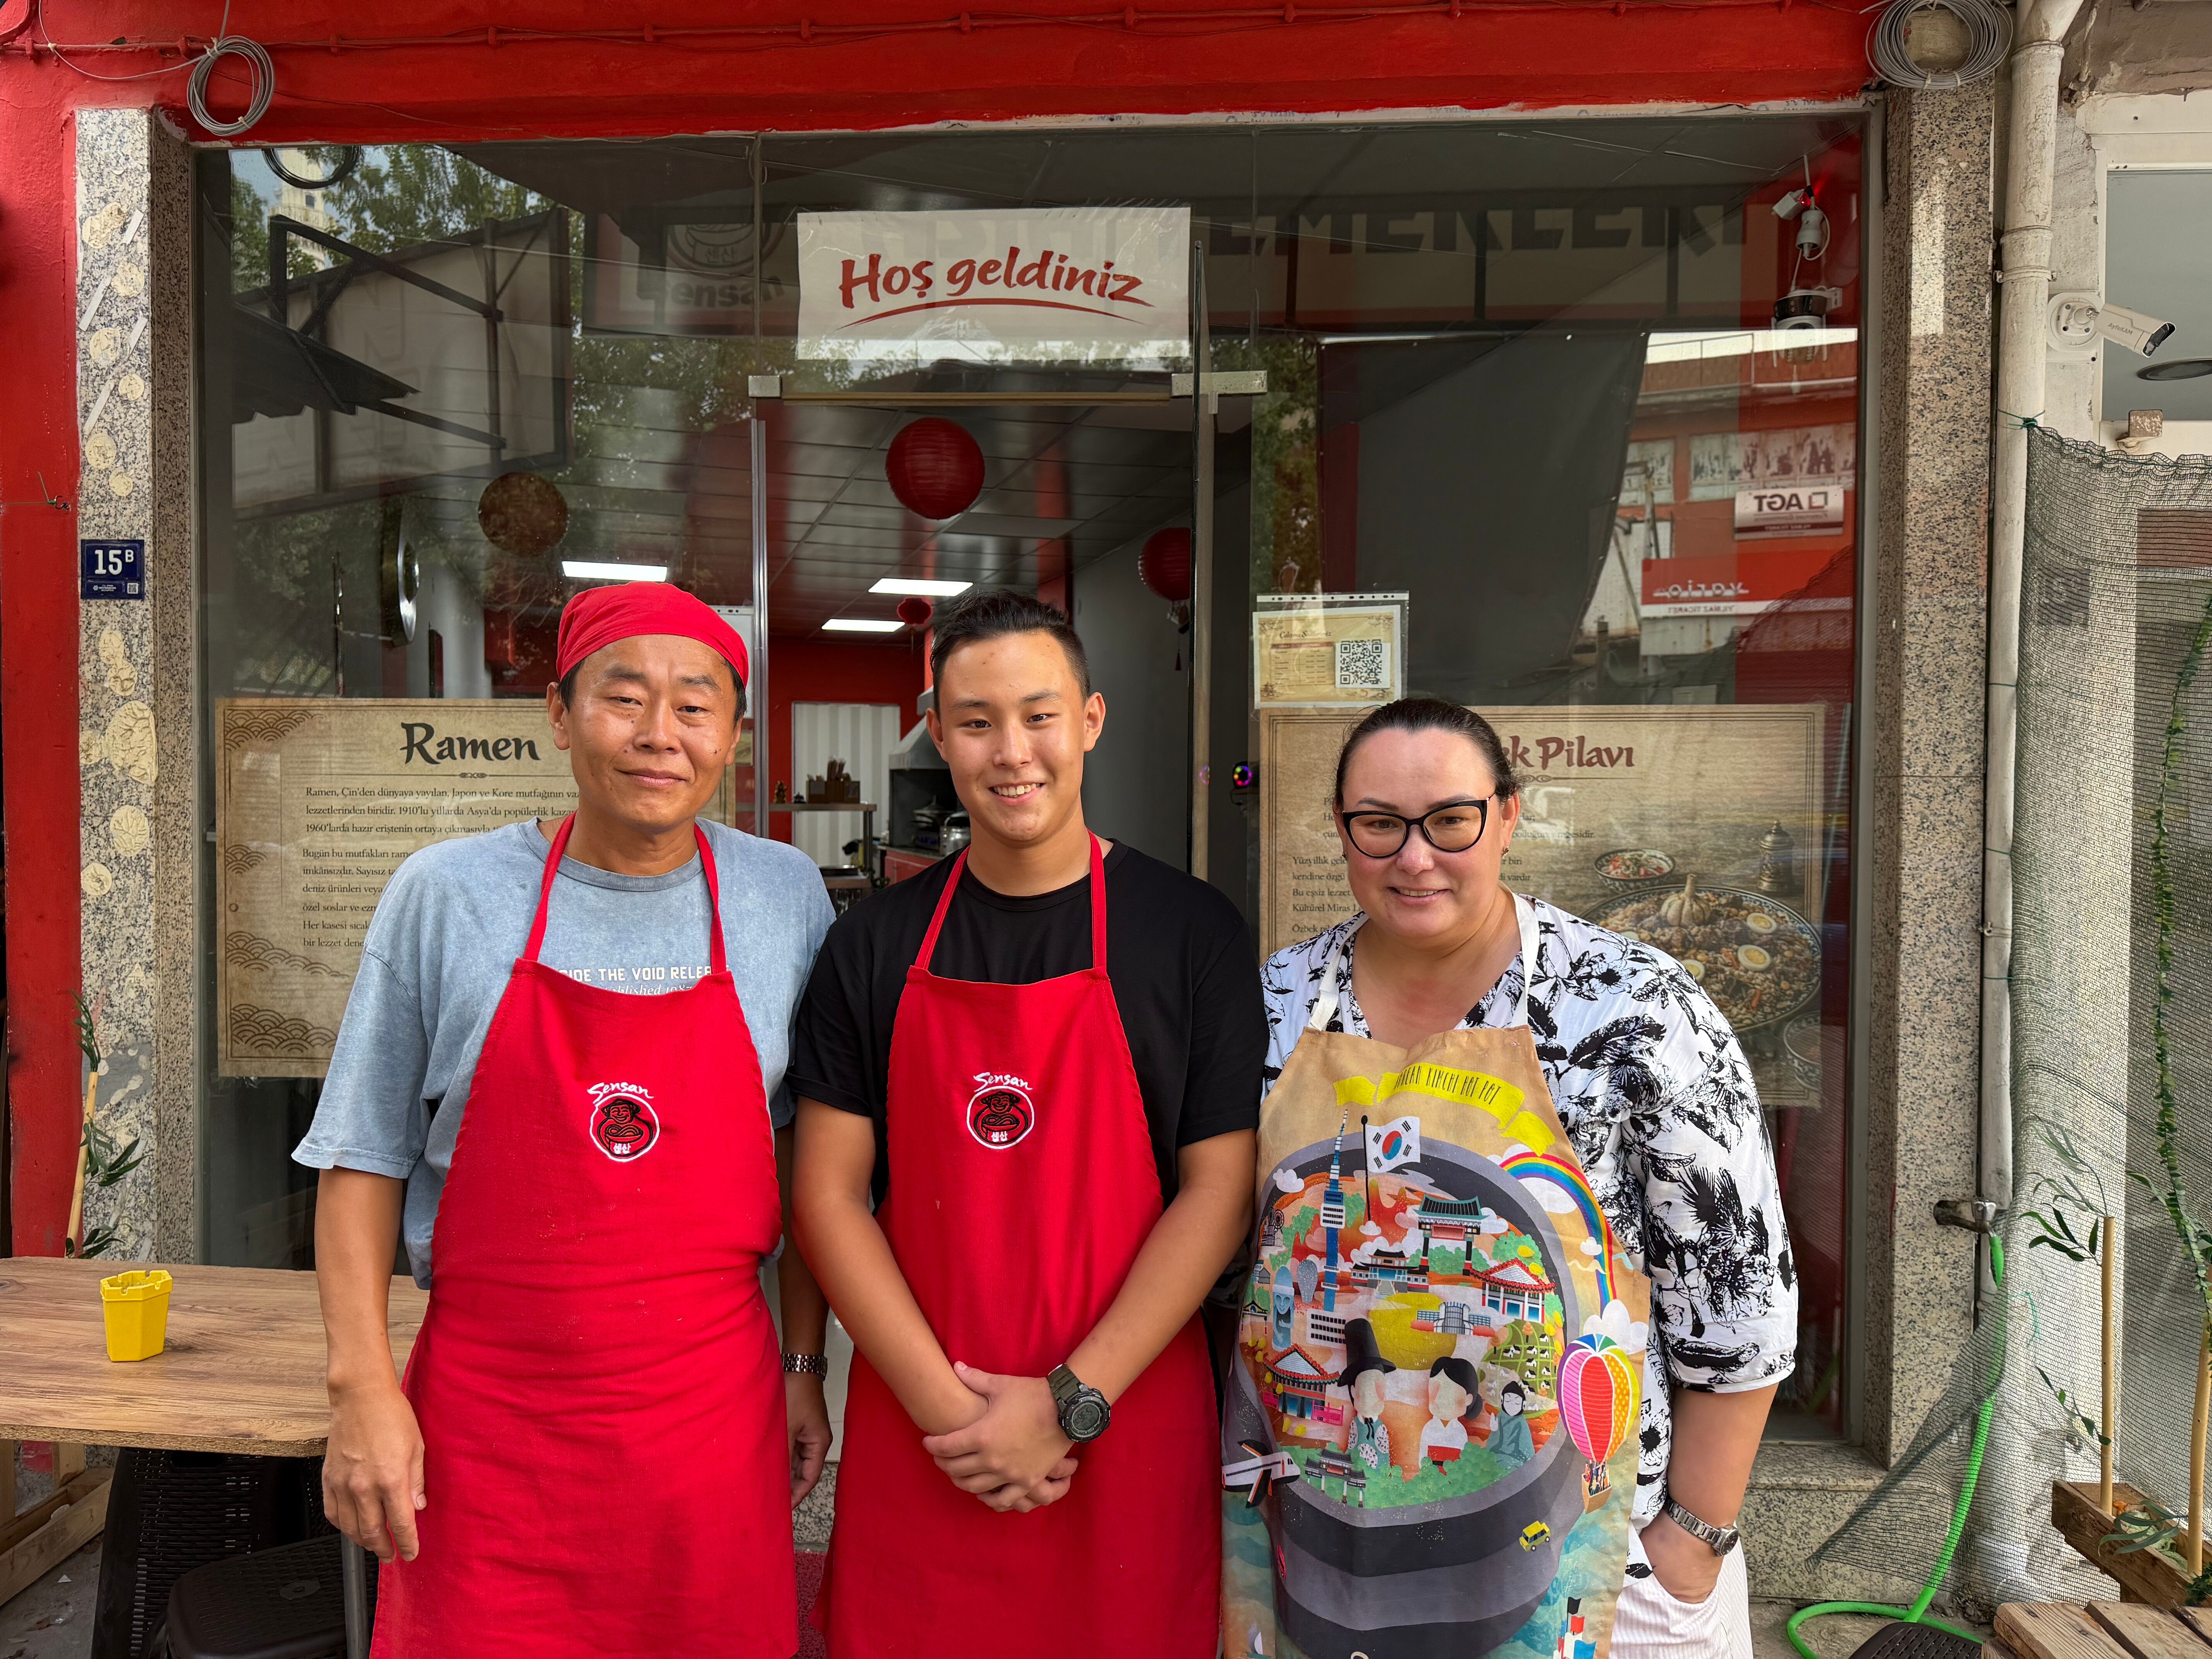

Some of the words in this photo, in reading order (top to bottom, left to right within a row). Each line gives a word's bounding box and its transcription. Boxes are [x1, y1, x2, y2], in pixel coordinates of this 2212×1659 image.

[838, 253, 934, 309] Hoş
[946, 246, 1155, 308] geldiniz
[400, 722, 541, 764] Ramen
[1535, 736, 1635, 770] Pilavı
[306, 787, 338, 797] Ramen,
[342, 787, 375, 798] Çin'den
[378, 788, 413, 799] dünyaya
[416, 788, 449, 799] yayılan,
[452, 788, 477, 799] Japon
[492, 789, 513, 797] Kore
[516, 789, 563, 799] mutfağının
[306, 805, 365, 814] lezzetlerinden
[368, 806, 395, 814] biridir.
[399, 806, 428, 815] 1910'lu
[467, 807, 501, 817] Asya'da
[504, 806, 549, 817] popülerlik
[306, 824, 349, 832] 1960'larda
[352, 824, 372, 832] hazır
[376, 824, 412, 834] eriştenin
[415, 825, 441, 835] ortaya
[302, 849, 329, 859] Bugün
[332, 849, 343, 857] bu
[345, 849, 388, 857] mutfakları
[357, 866, 385, 877] Sayısız
[1326, 872, 1345, 882] özgü
[303, 884, 325, 893] deniz
[328, 884, 361, 893] ürünleri
[364, 887, 383, 895] veya
[1293, 903, 1324, 912] Kültürel
[303, 921, 319, 929] Her
[322, 921, 347, 929] kasesi
[1292, 924, 1318, 932] Özbek
[304, 938, 315, 946] bir
[318, 938, 341, 946] lezzet
[598, 968, 625, 981] THE
[632, 967, 665, 981] VOID
[973, 1072, 1033, 1092] Sensan
[1426, 1067, 1459, 1093] KIMCHI
[1460, 1075, 1480, 1097] HOT
[1479, 1080, 1502, 1105] POT
[587, 1082, 654, 1104] Sensan
